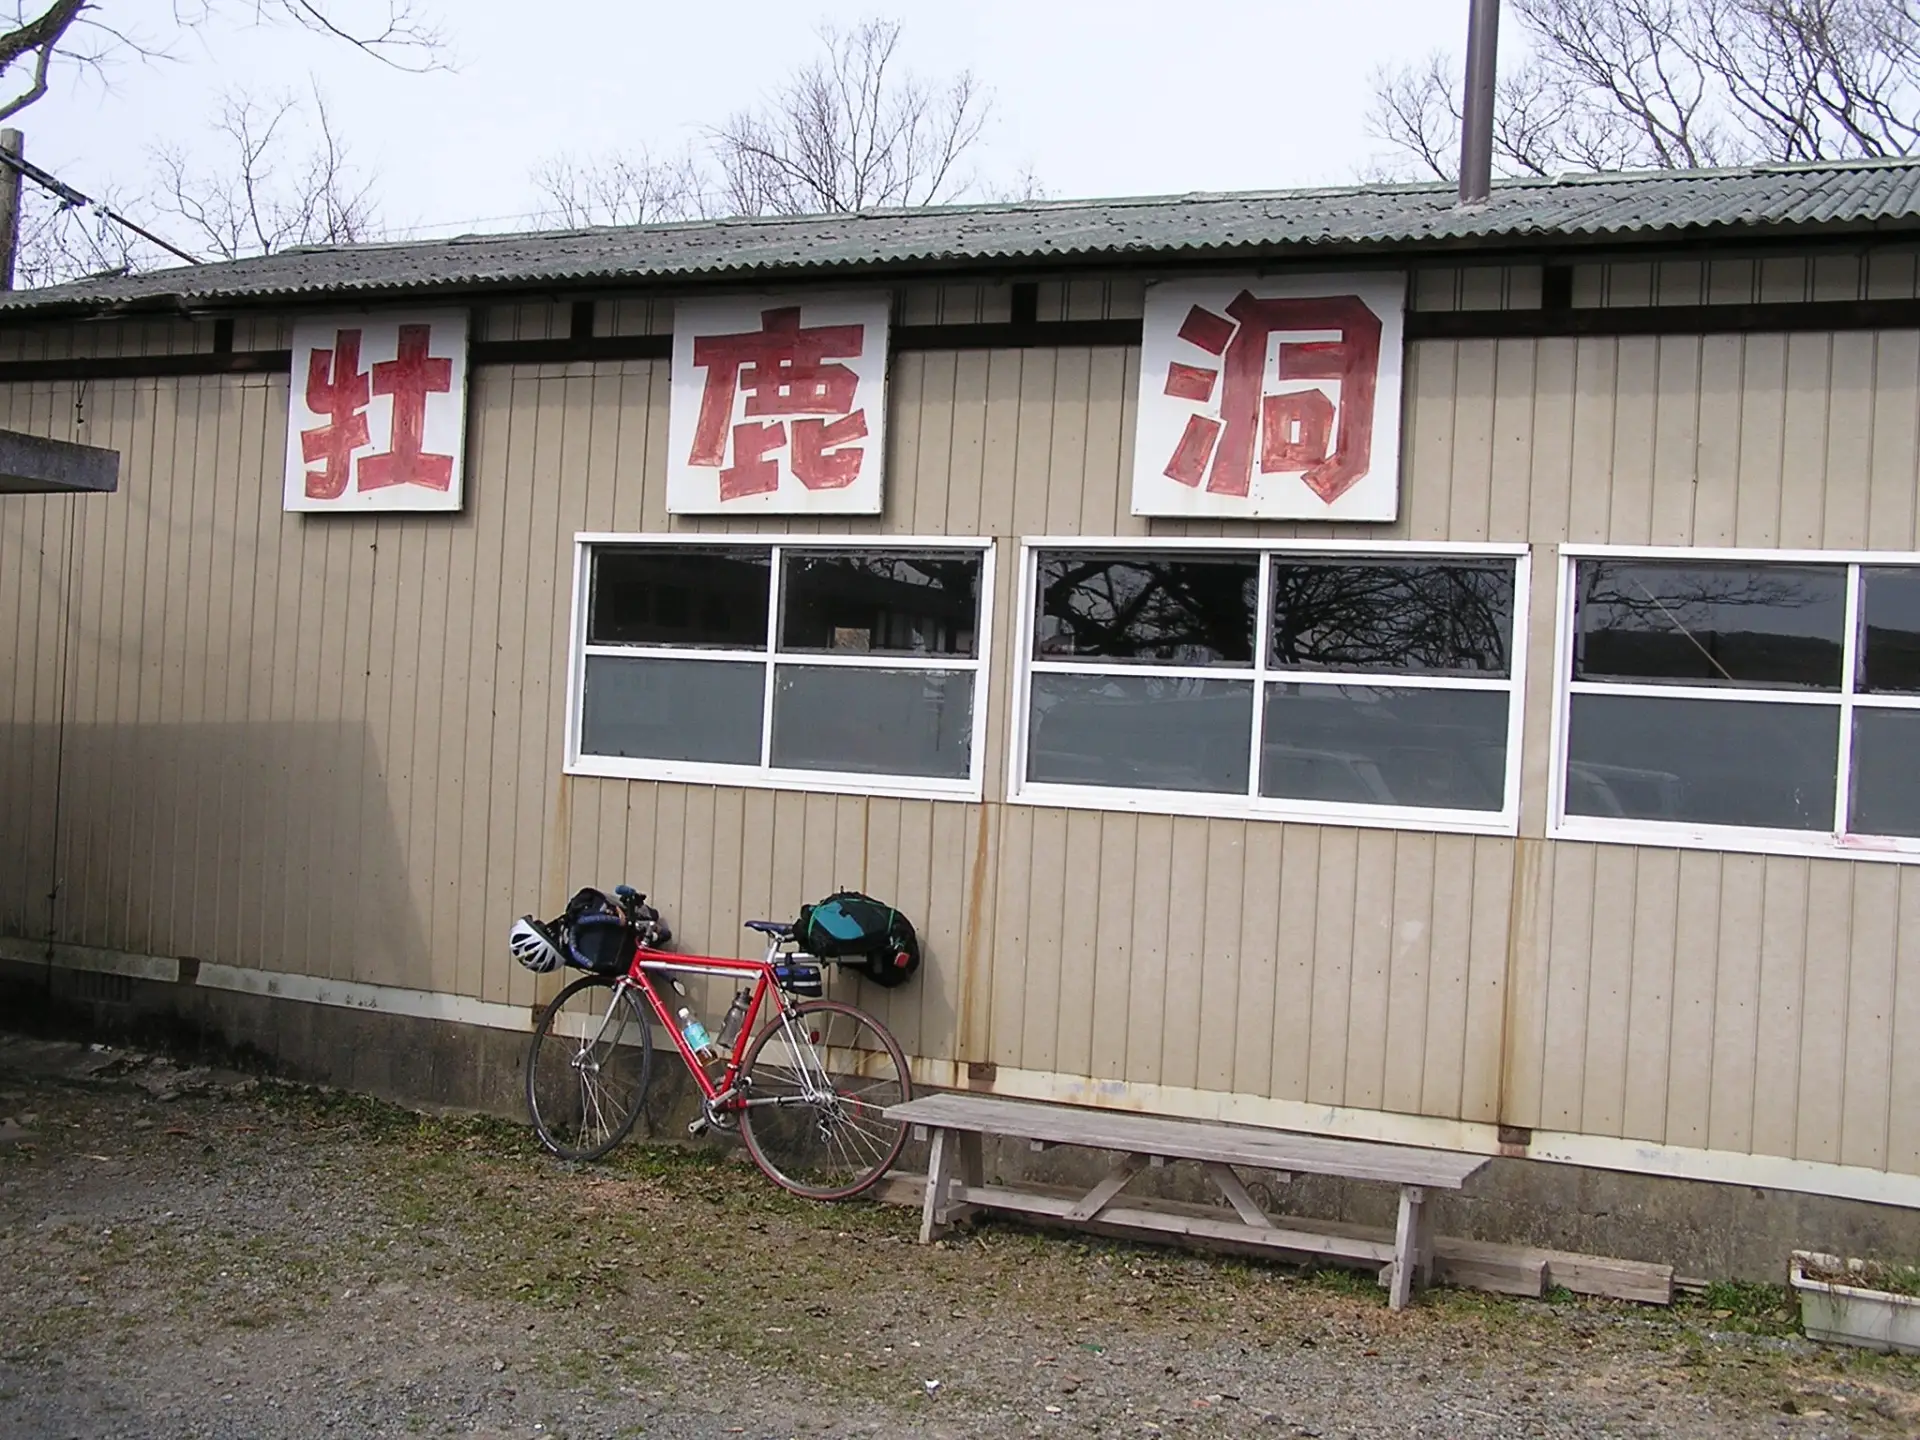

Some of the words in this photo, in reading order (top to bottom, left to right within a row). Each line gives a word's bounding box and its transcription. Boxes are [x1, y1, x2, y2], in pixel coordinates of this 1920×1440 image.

[299, 323, 454, 500] 牡
[688, 306, 869, 503] 鹿
[1163, 288, 1384, 505] 洞
